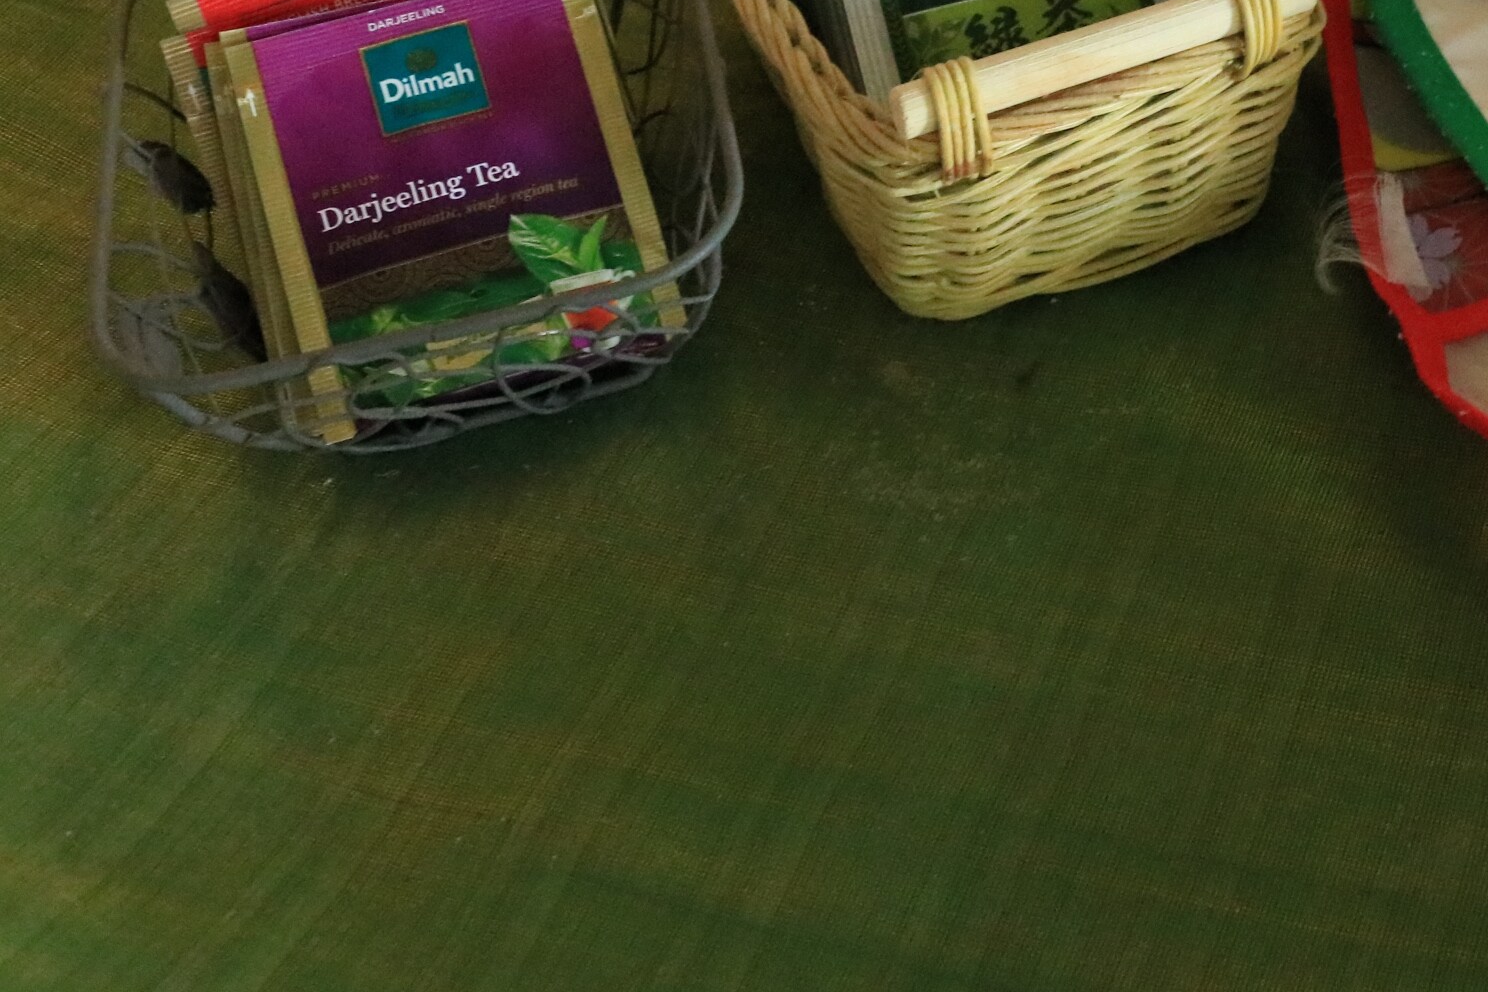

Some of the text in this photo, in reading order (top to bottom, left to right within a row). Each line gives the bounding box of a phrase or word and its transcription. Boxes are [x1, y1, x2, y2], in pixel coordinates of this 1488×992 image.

[367, 5, 446, 32] DARJEELING
[379, 62, 475, 104] Dilmah
[317, 161, 520, 233] Darjeeling Tea
